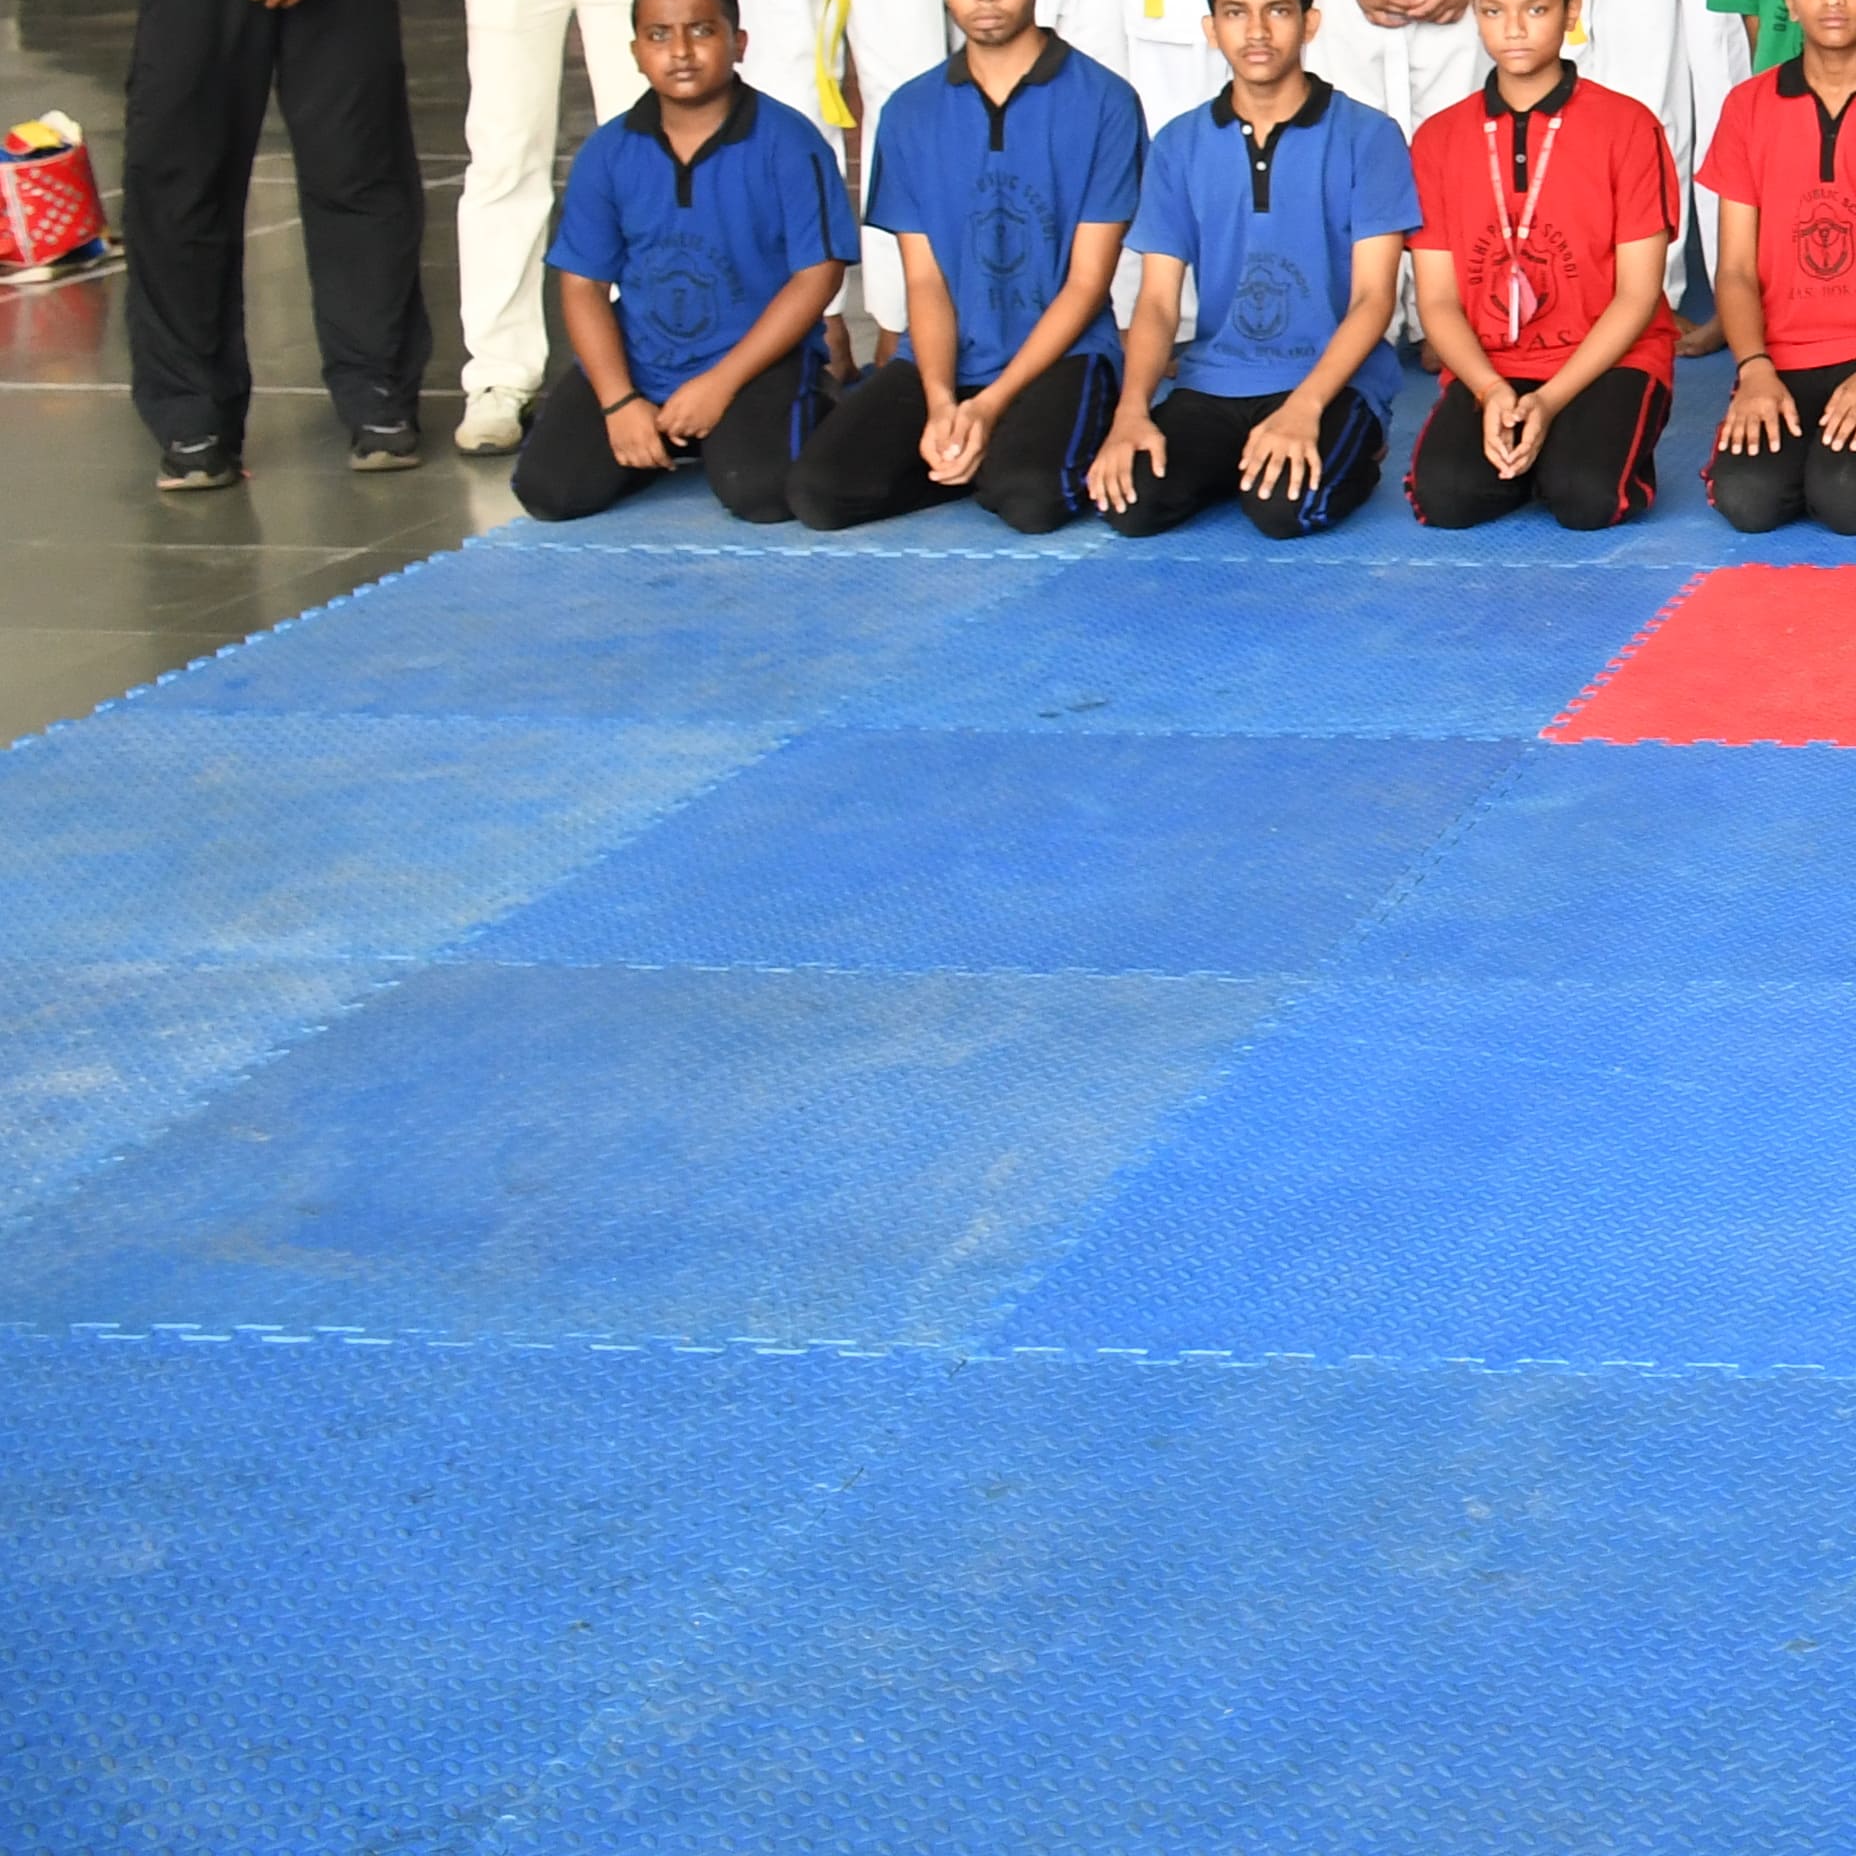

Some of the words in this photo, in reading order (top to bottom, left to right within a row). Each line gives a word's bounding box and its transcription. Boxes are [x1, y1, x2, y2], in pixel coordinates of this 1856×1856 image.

[1801, 188, 1839, 203] UBLIC
[1468, 236, 1492, 286] DELHI
[1543, 223, 1580, 280] SCHOOL
